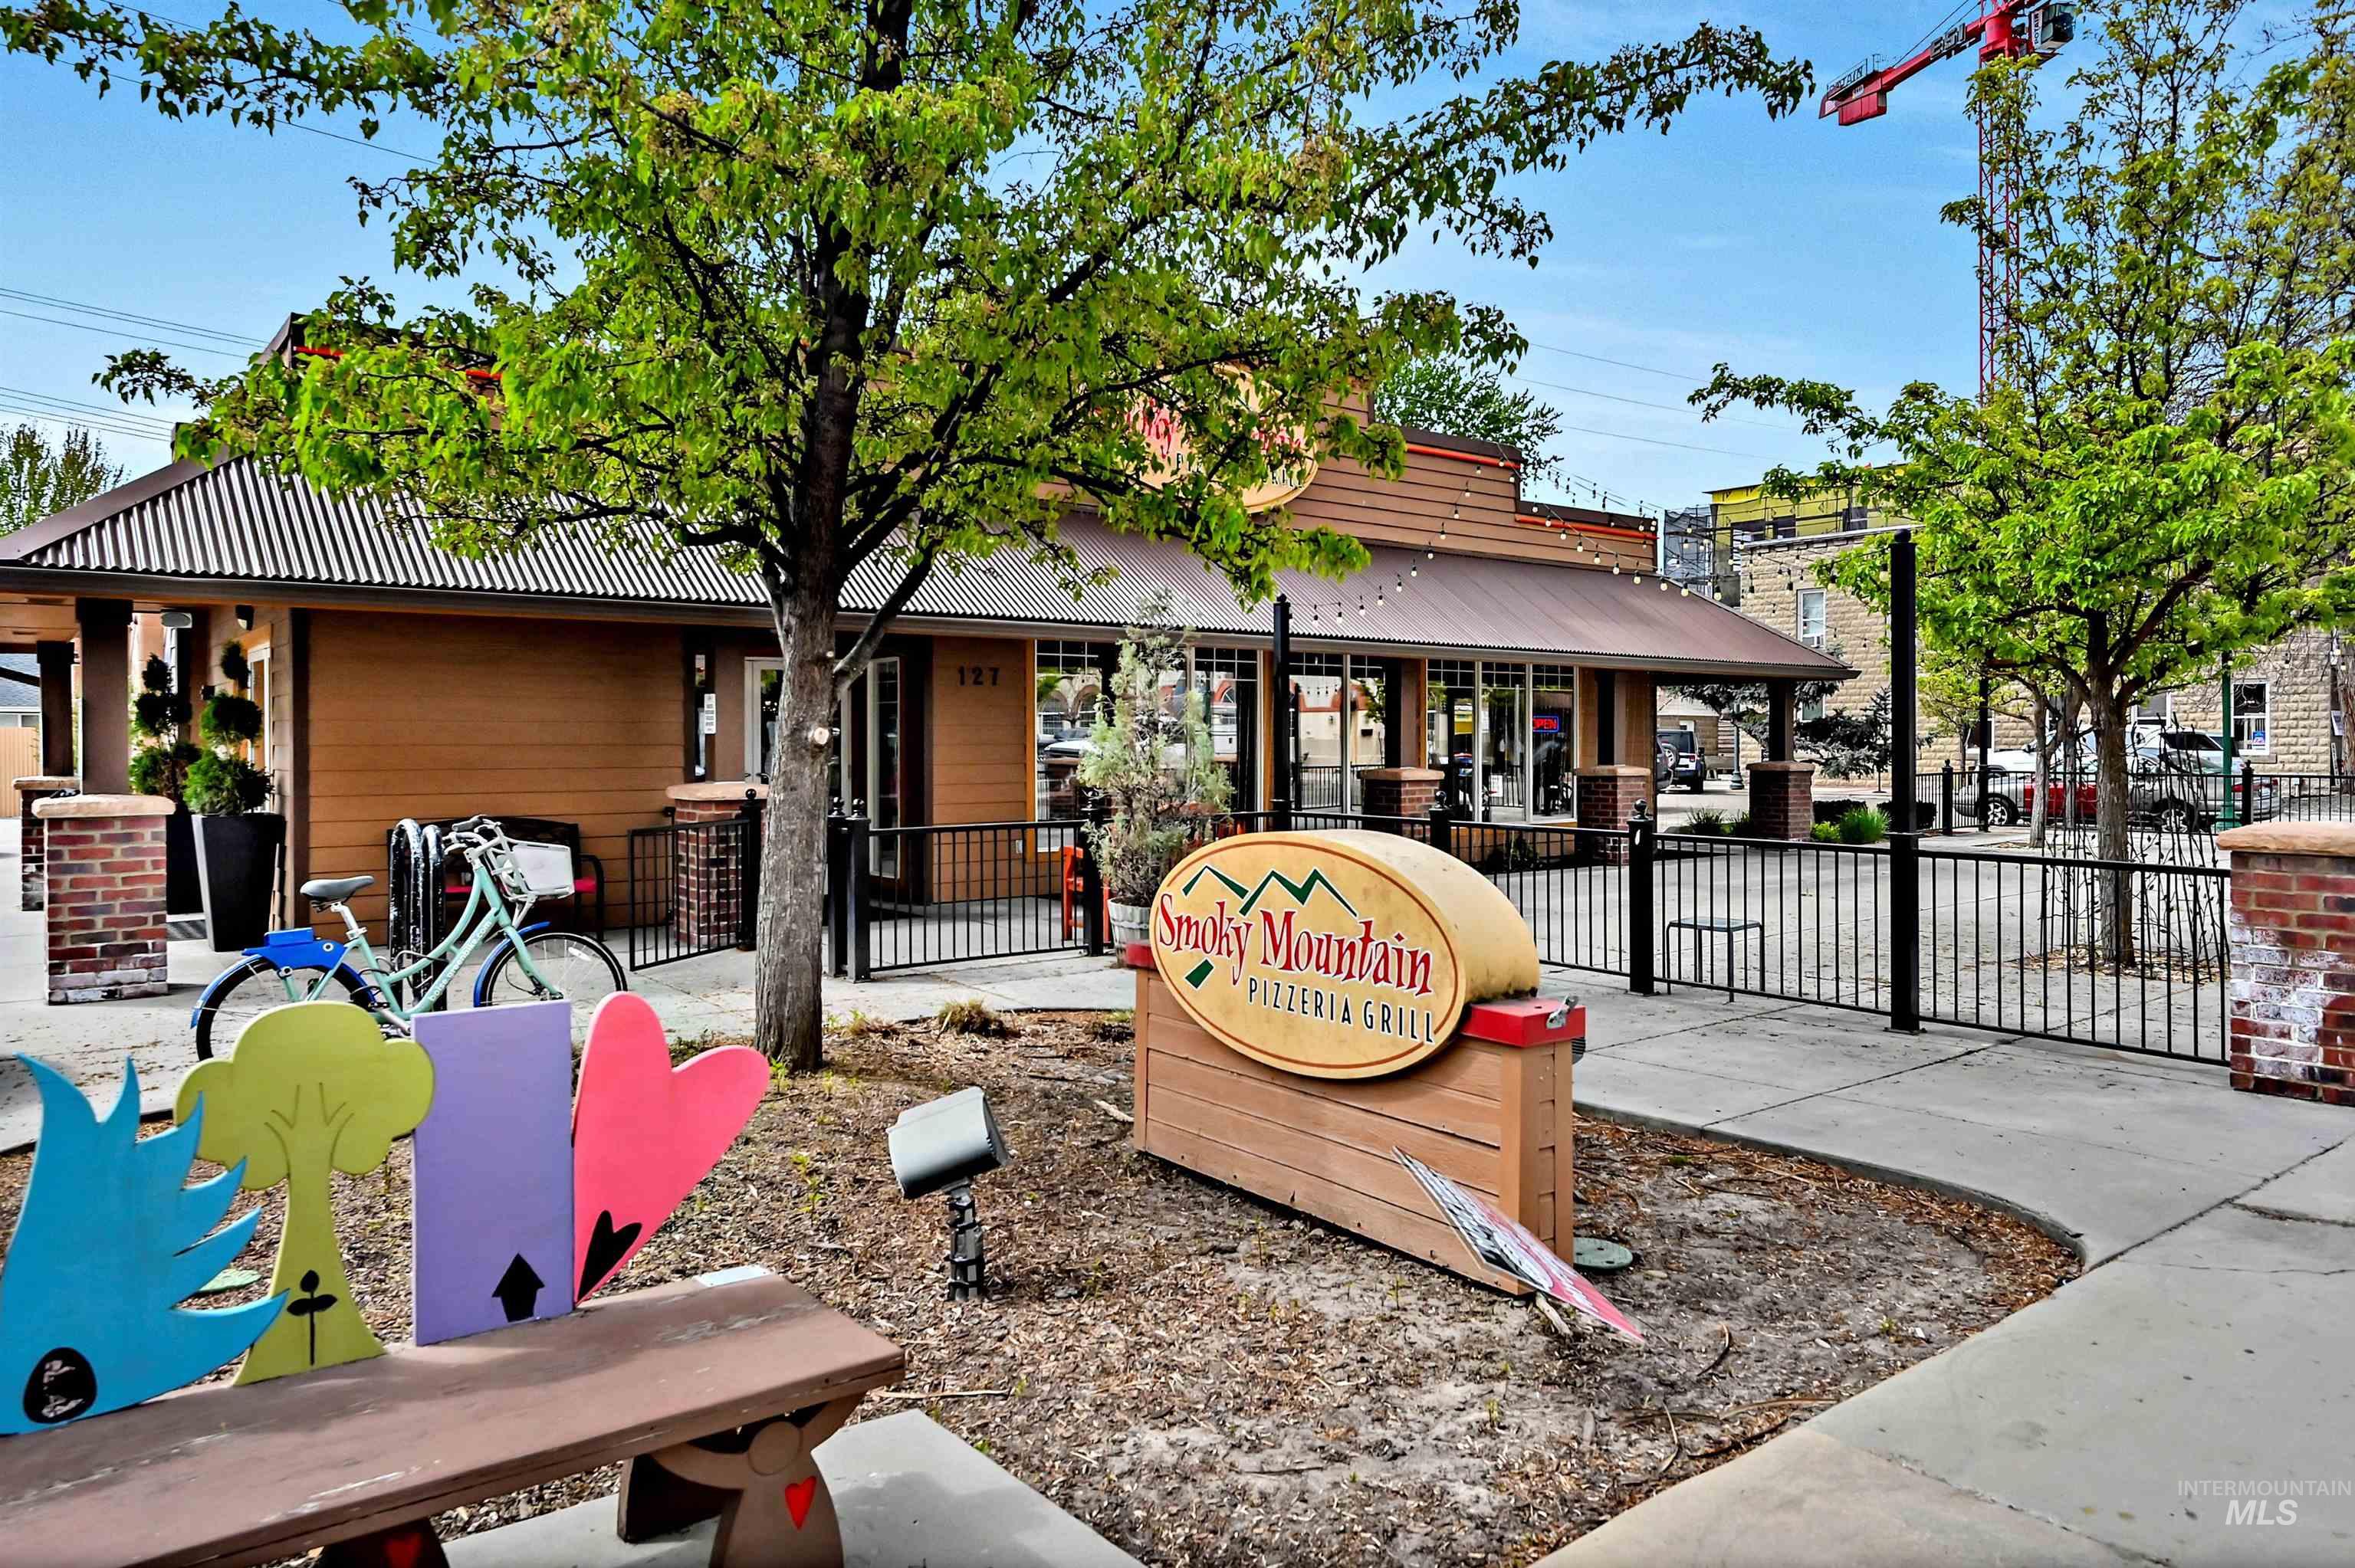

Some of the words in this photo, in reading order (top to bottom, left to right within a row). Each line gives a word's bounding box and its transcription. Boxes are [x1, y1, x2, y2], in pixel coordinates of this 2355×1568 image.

[957, 665, 1000, 686] 127
[1160, 894, 1253, 986] Smoky
[1260, 910, 1432, 996] Mountain
[1250, 977, 1352, 1025] PIZZERIA
[1363, 1001, 1434, 1043] GRILL
